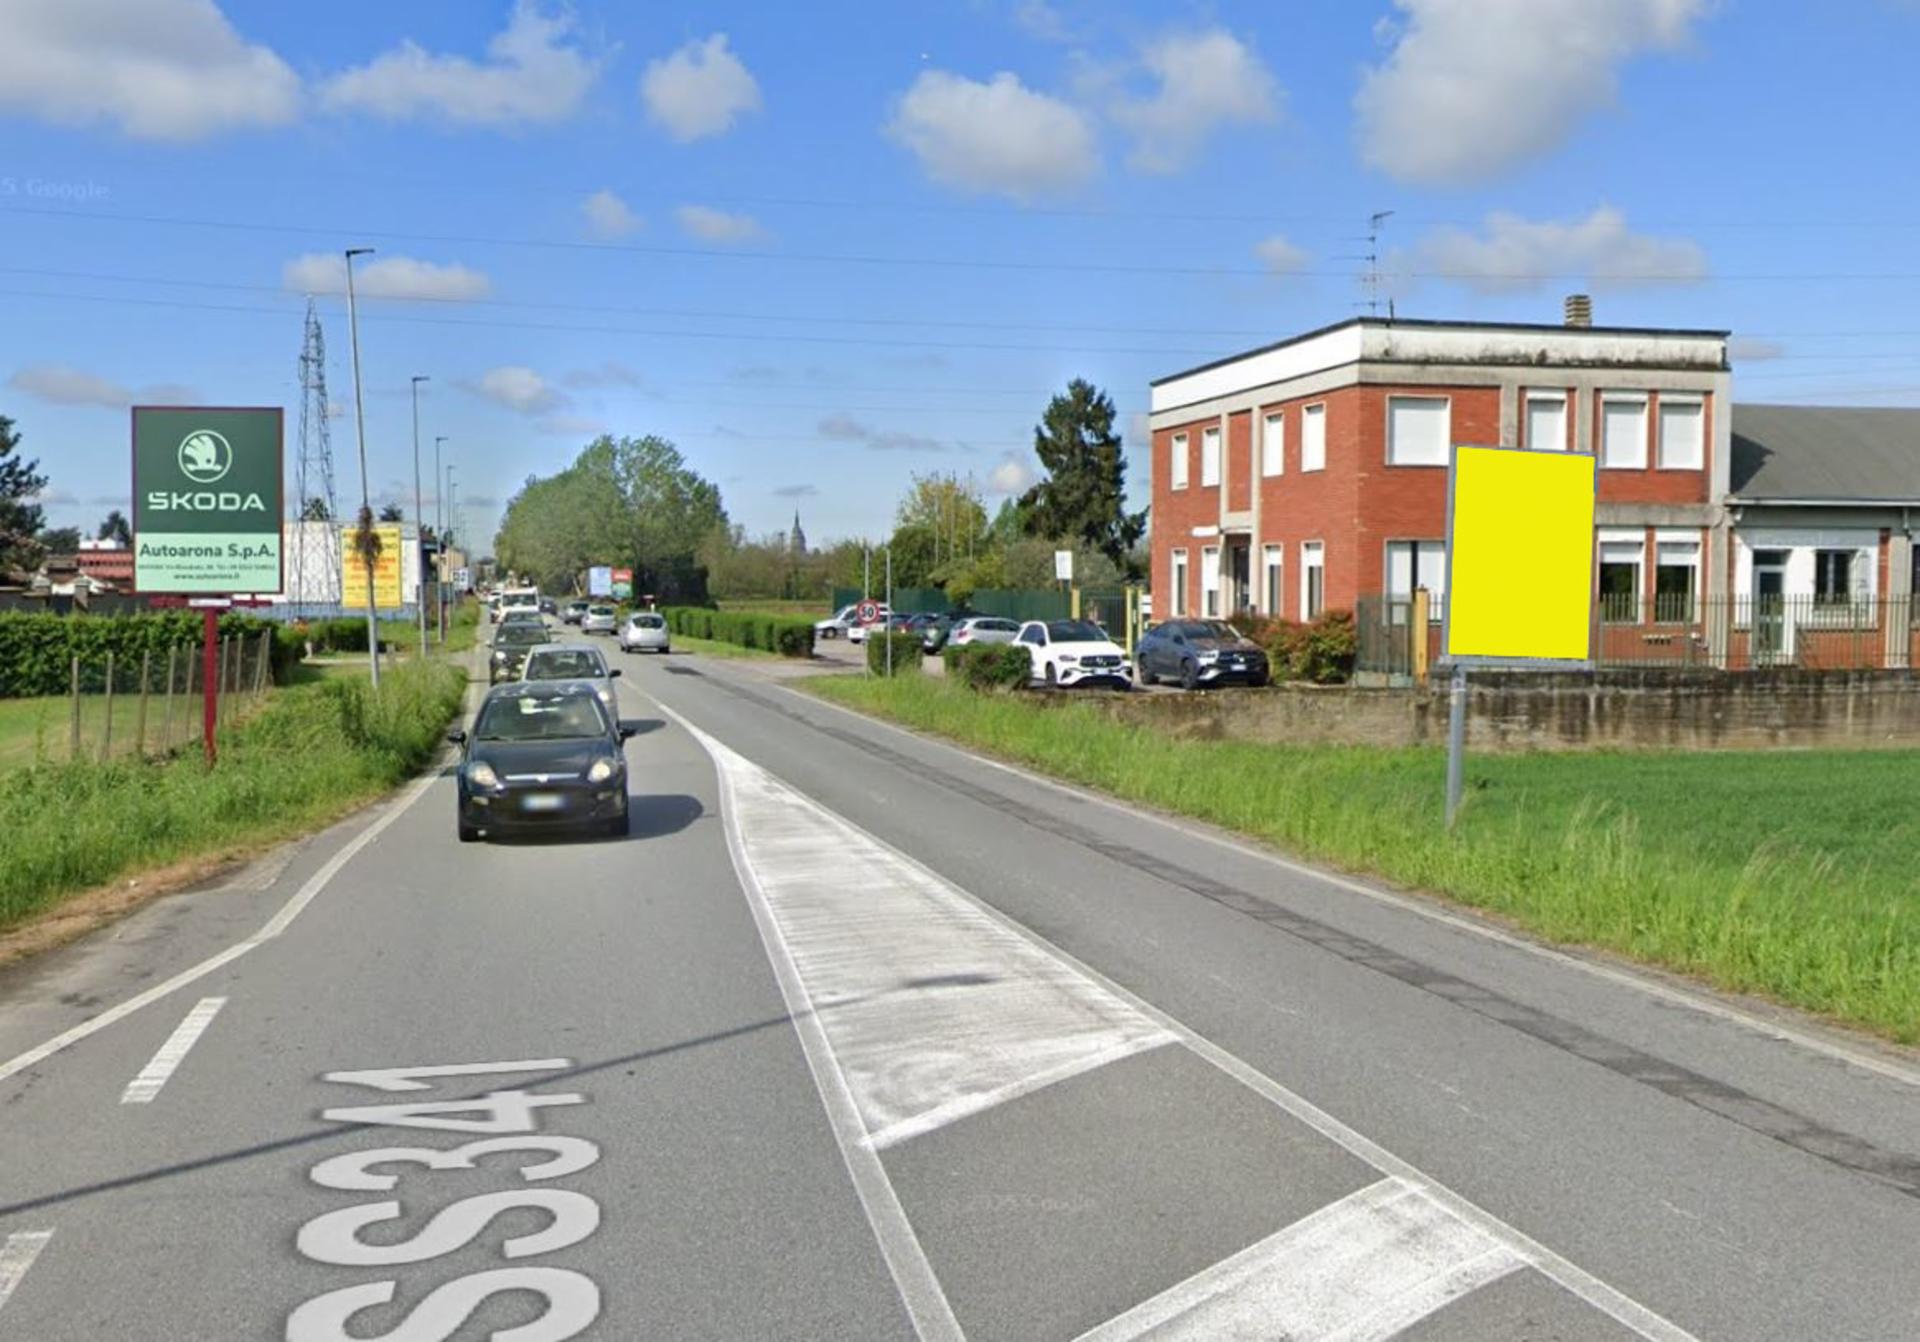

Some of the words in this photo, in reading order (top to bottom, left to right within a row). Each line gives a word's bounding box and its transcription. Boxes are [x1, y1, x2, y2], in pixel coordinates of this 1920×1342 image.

[139, 543, 222, 557] Autoarona
[228, 543, 275, 560] S.p.A.
[862, 606, 874, 618] 50
